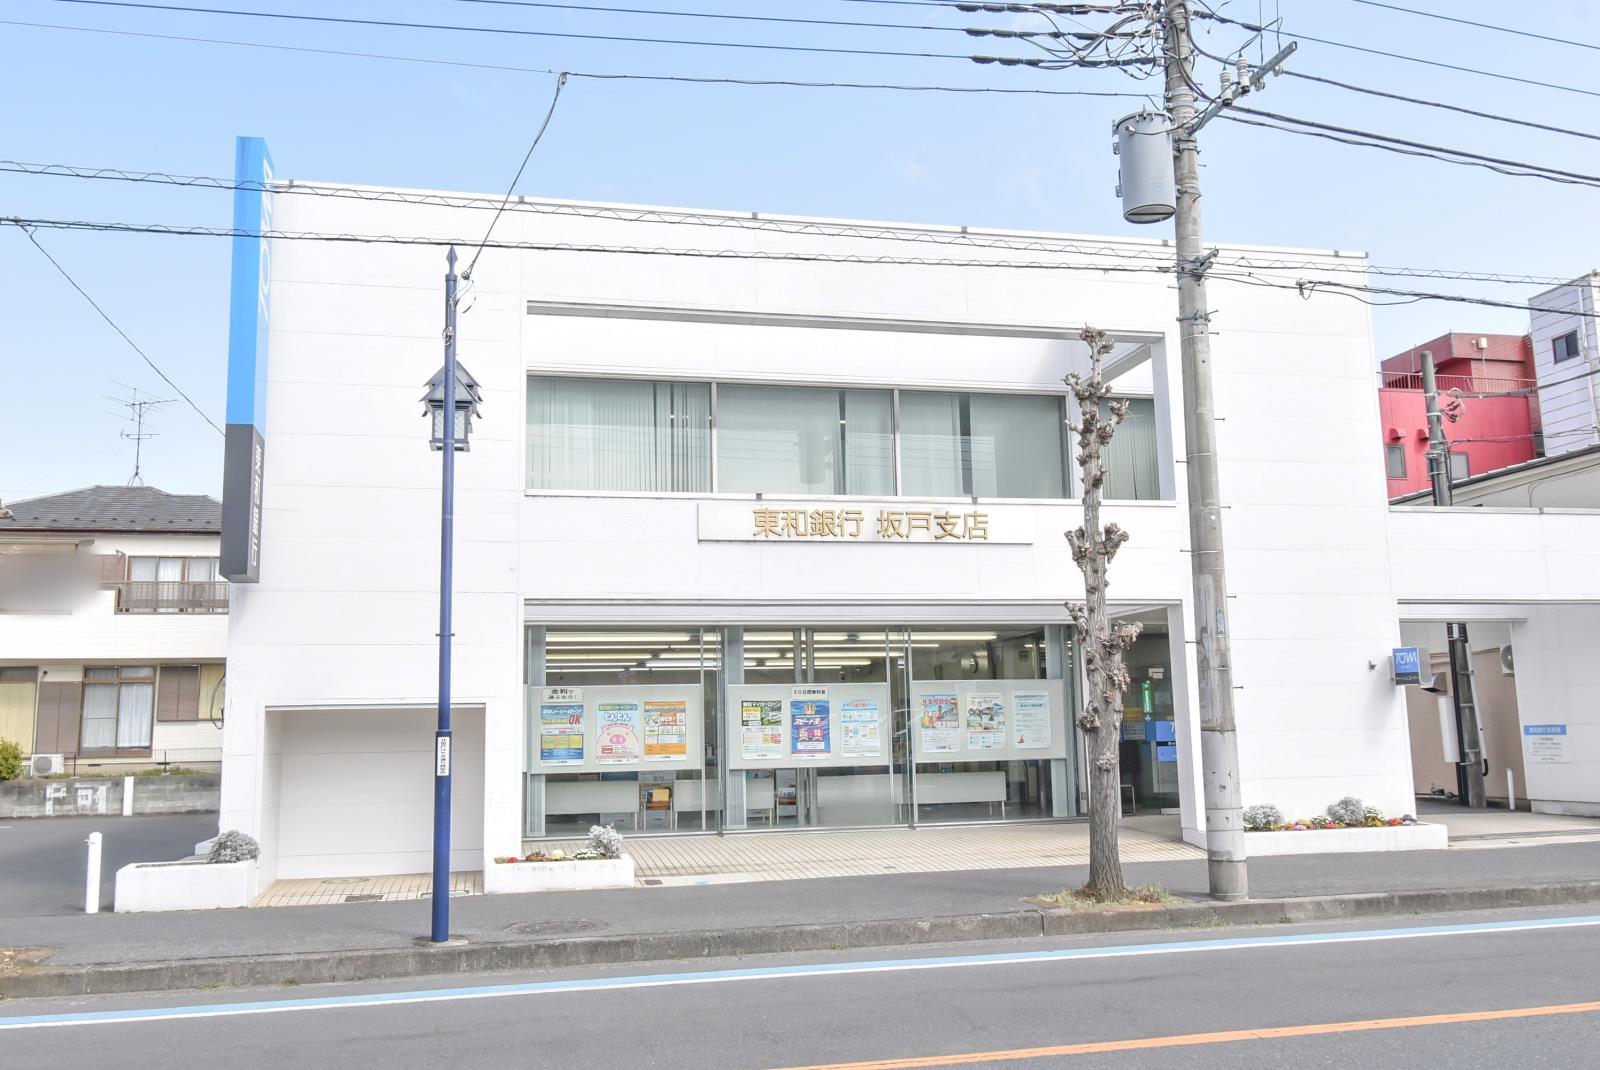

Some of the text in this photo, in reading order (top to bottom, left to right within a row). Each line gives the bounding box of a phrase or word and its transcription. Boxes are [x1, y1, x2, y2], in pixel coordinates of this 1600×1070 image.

[258, 157, 274, 323] TOWA
[753, 507, 989, 541] 東和銀行 坂戸支店
[1394, 651, 1417, 664] TOWA
[568, 714, 581, 725] OK
[604, 711, 631, 722] とんとん
